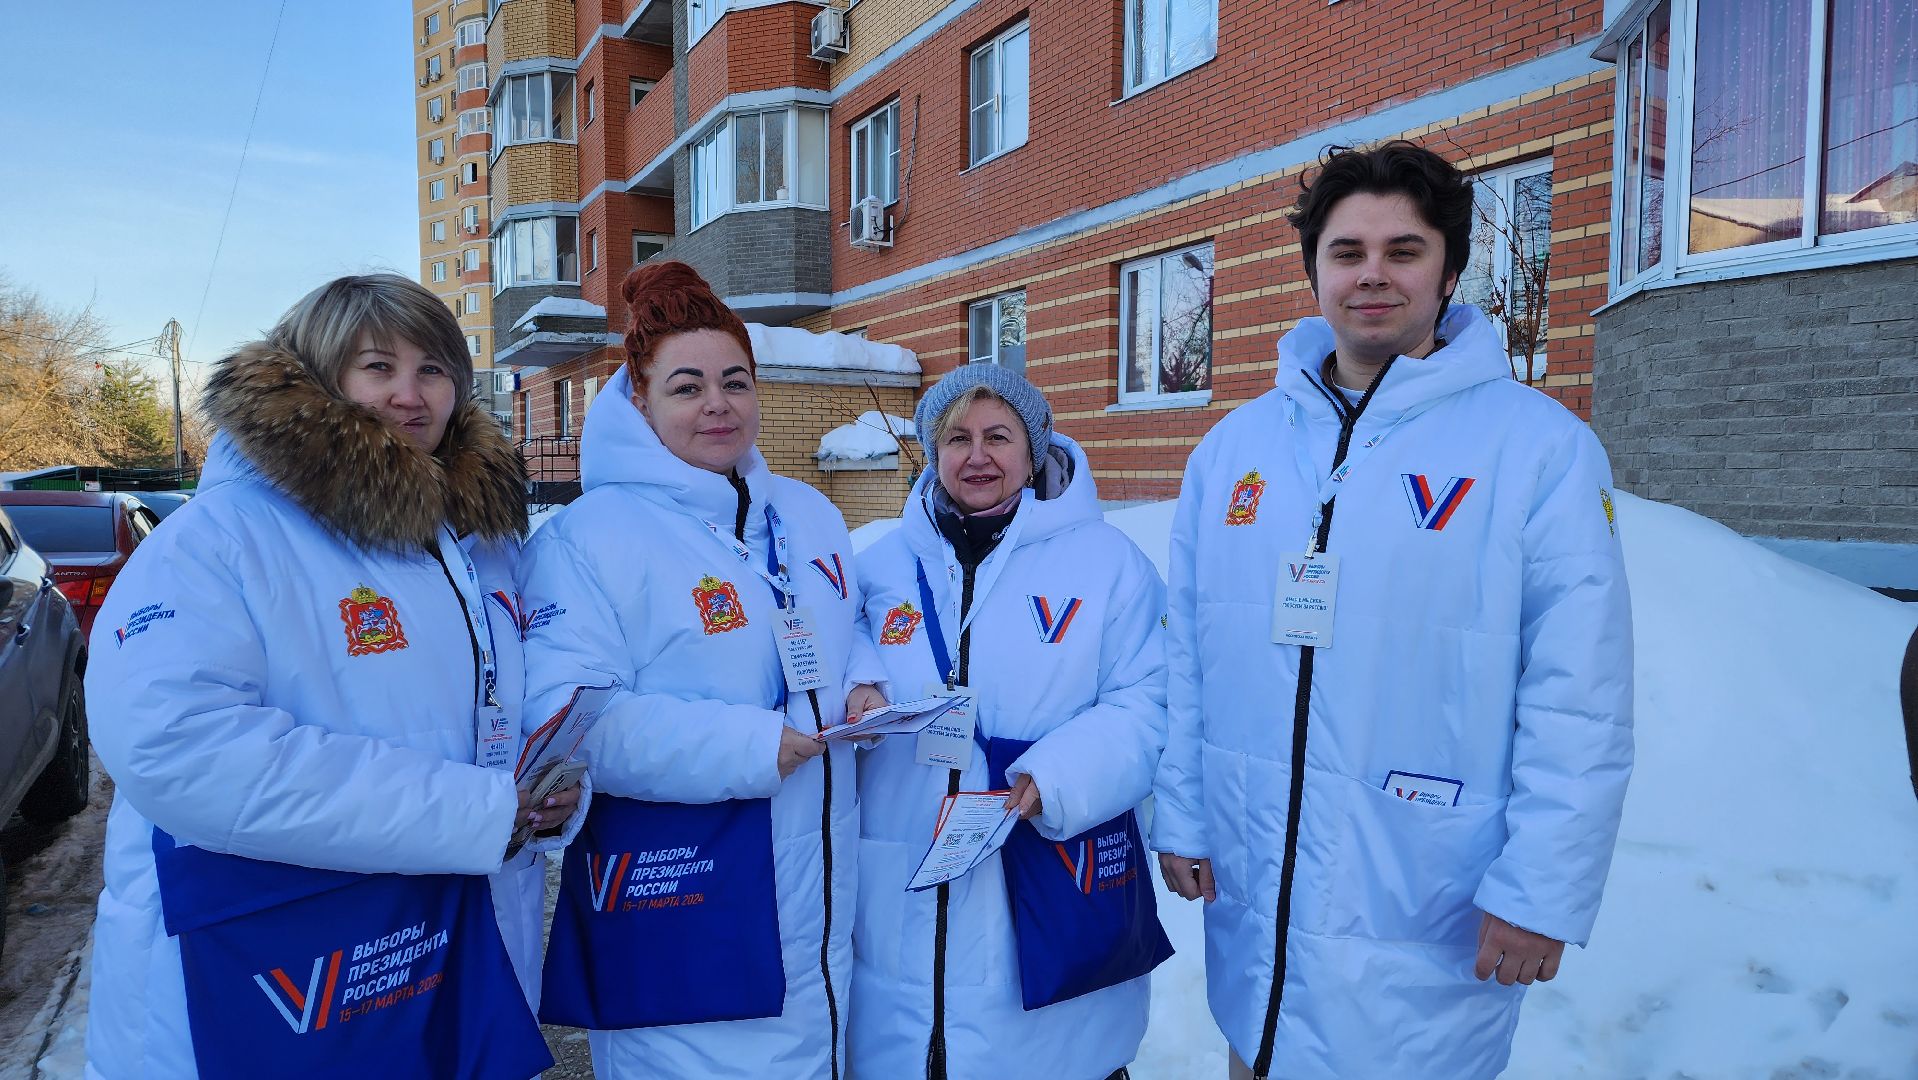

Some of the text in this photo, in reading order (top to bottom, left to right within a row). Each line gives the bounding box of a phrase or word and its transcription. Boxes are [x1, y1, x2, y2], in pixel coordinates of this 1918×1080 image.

[637, 845, 699, 864] ВЫБОРЫ
[631, 859, 714, 881] ПРЕЗИДЕНТА
[1098, 861, 1126, 879] РОССИ
[626, 880, 679, 897] РОССИИ
[648, 895, 681, 909] МАРТА
[351, 920, 426, 962] ВЫБОРЫ
[346, 928, 449, 984] ПРЕЗИДЕНТА
[342, 966, 411, 1006] РОССИИ
[375, 984, 414, 1011] МАРТА
